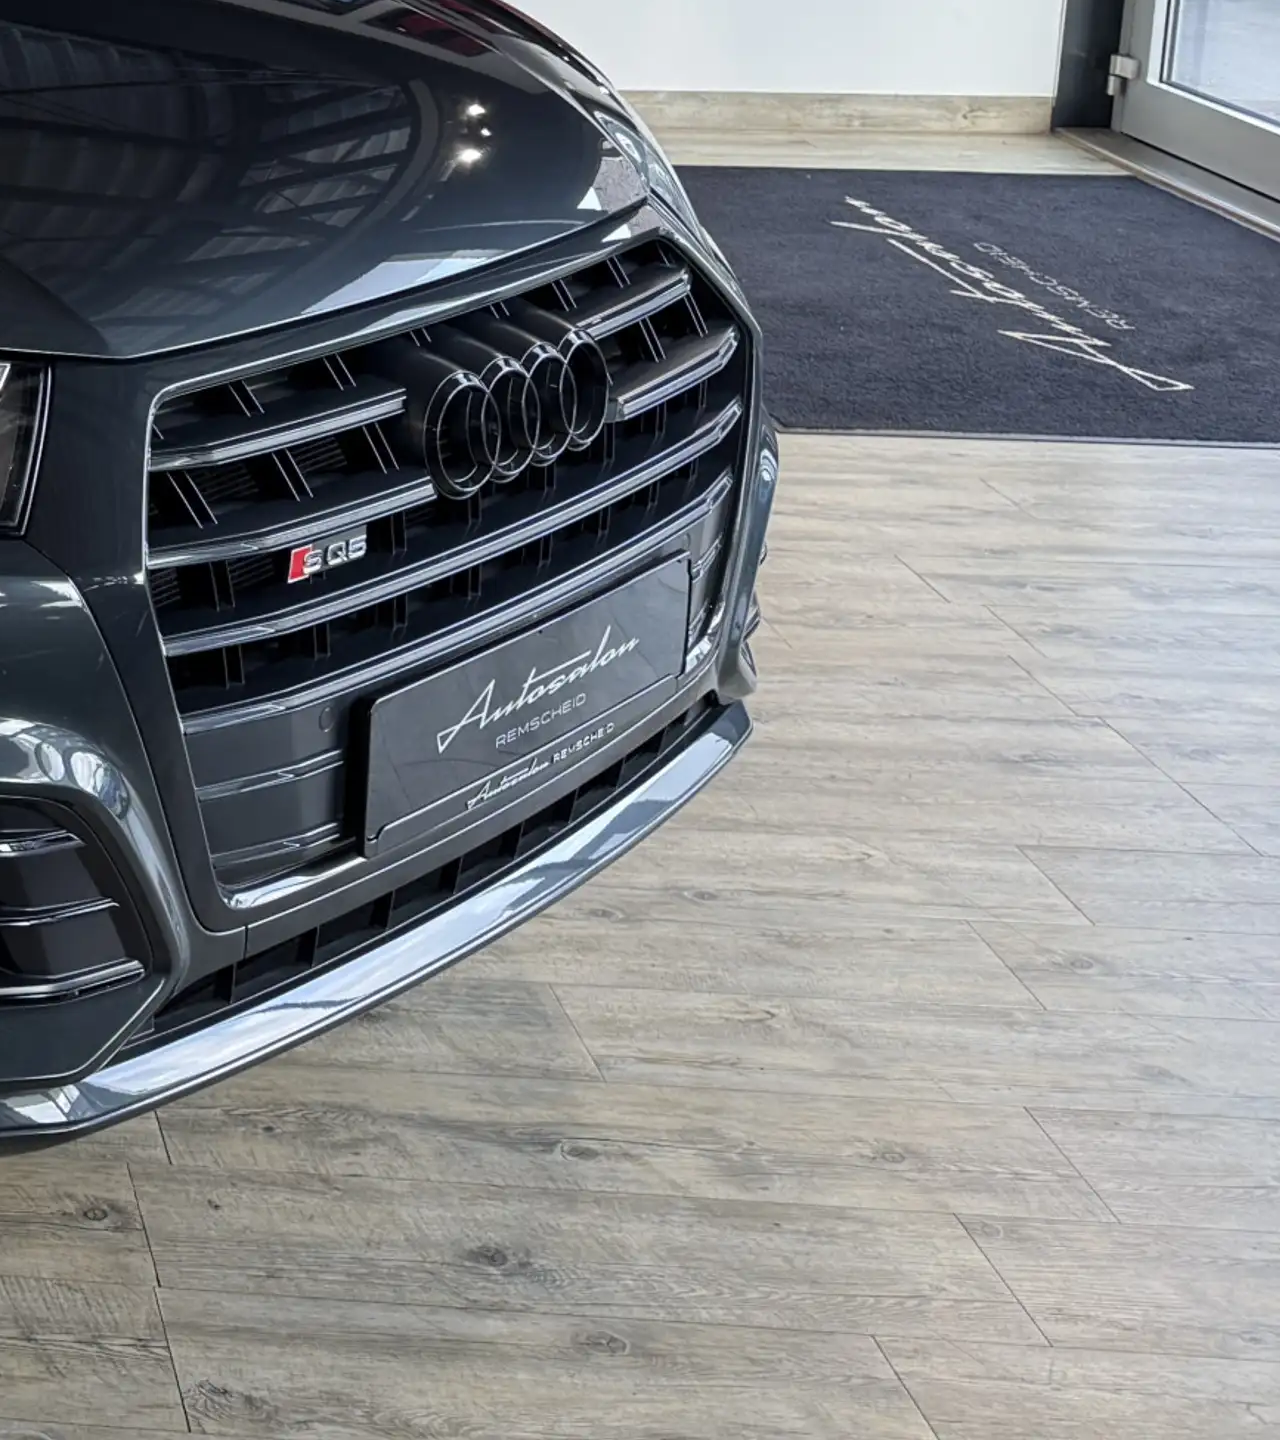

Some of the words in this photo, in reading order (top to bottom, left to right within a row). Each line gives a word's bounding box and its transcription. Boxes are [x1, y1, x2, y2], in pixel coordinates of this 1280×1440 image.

[436, 624, 640, 755] Autosalon
[495, 692, 587, 749] REMSCHEID
[466, 757, 550, 810] Autosalon
[552, 722, 616, 763] REMSCHEID
